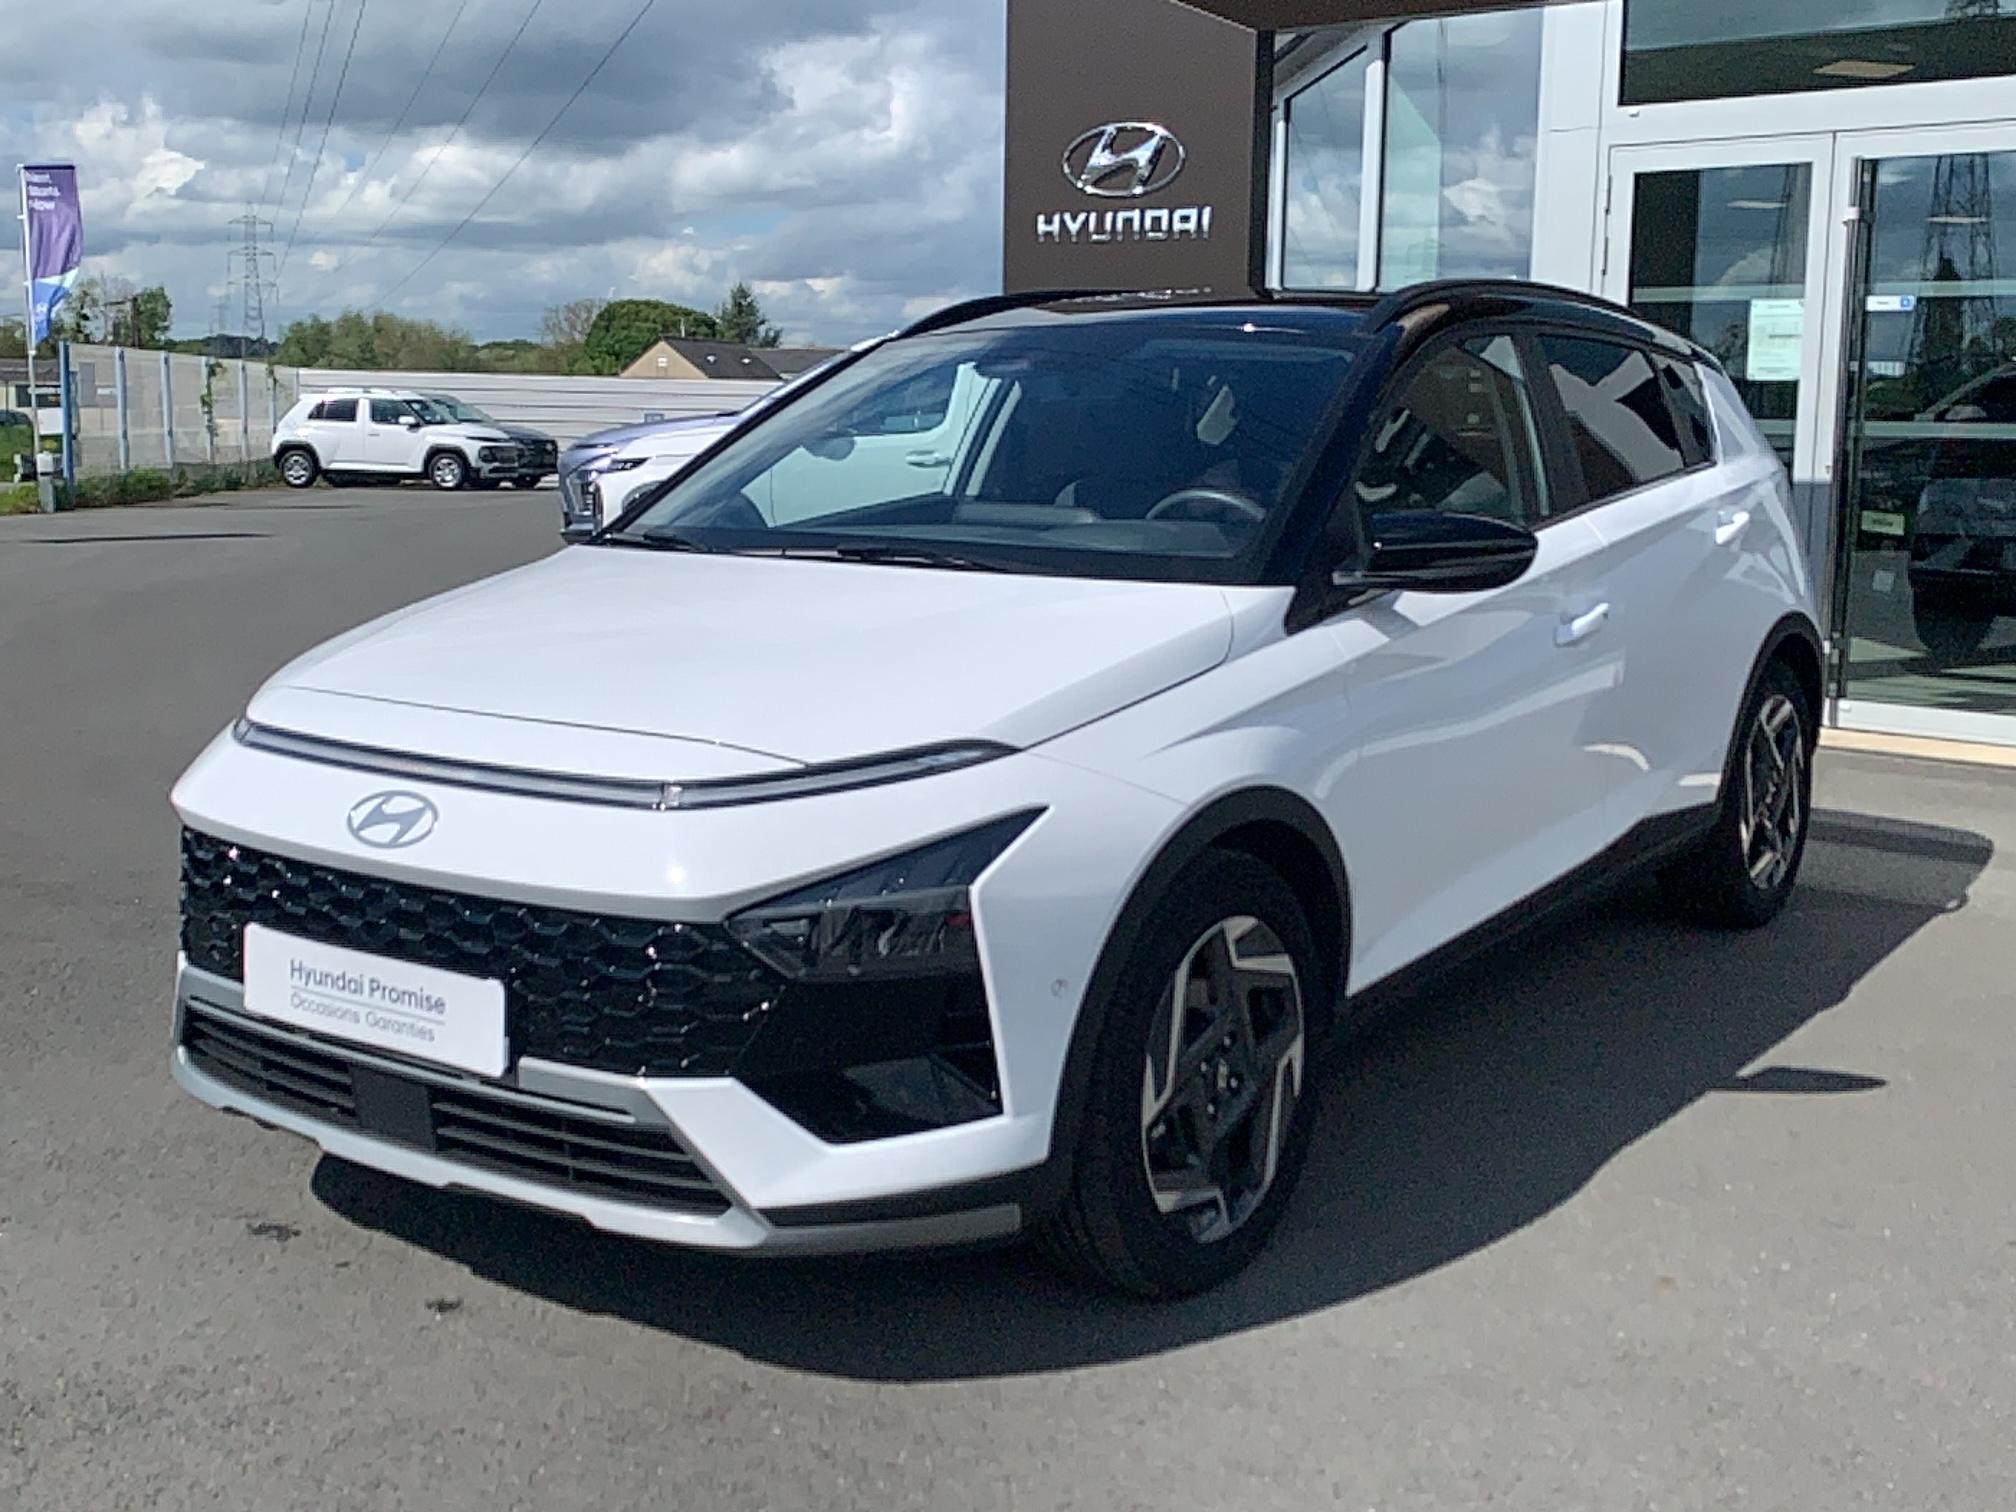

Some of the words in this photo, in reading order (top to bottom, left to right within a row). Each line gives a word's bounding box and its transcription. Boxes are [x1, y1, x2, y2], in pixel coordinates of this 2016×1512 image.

[1036, 206, 1213, 242] HYUNDAI
[290, 959, 364, 997] Hyundai
[368, 977, 446, 1014] Promise
[290, 991, 361, 1024] Occasions
